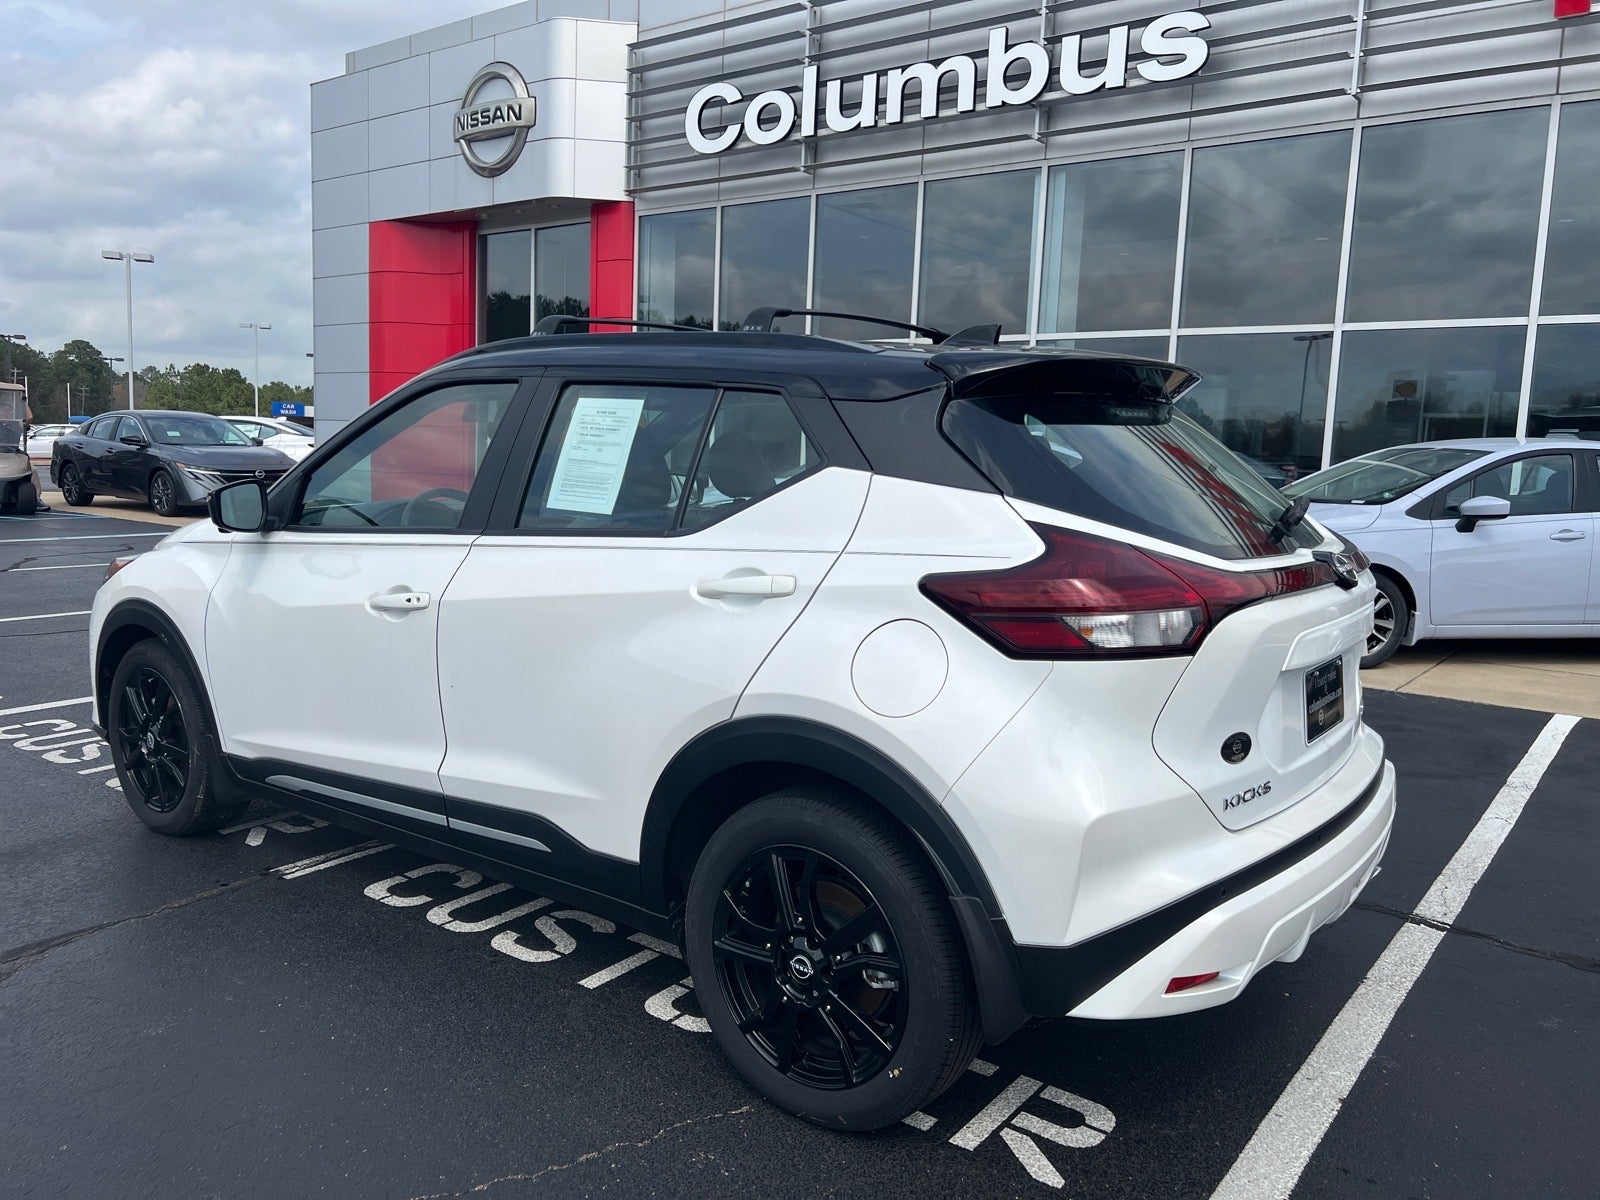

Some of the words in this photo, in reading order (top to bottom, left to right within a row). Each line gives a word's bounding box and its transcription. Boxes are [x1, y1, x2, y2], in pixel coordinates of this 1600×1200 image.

[456, 103, 522, 133] NISSAN
[685, 10, 1211, 154] Columbus
[1223, 780, 1271, 811] KICKS
[364, 864, 1116, 1188] CUSTR
